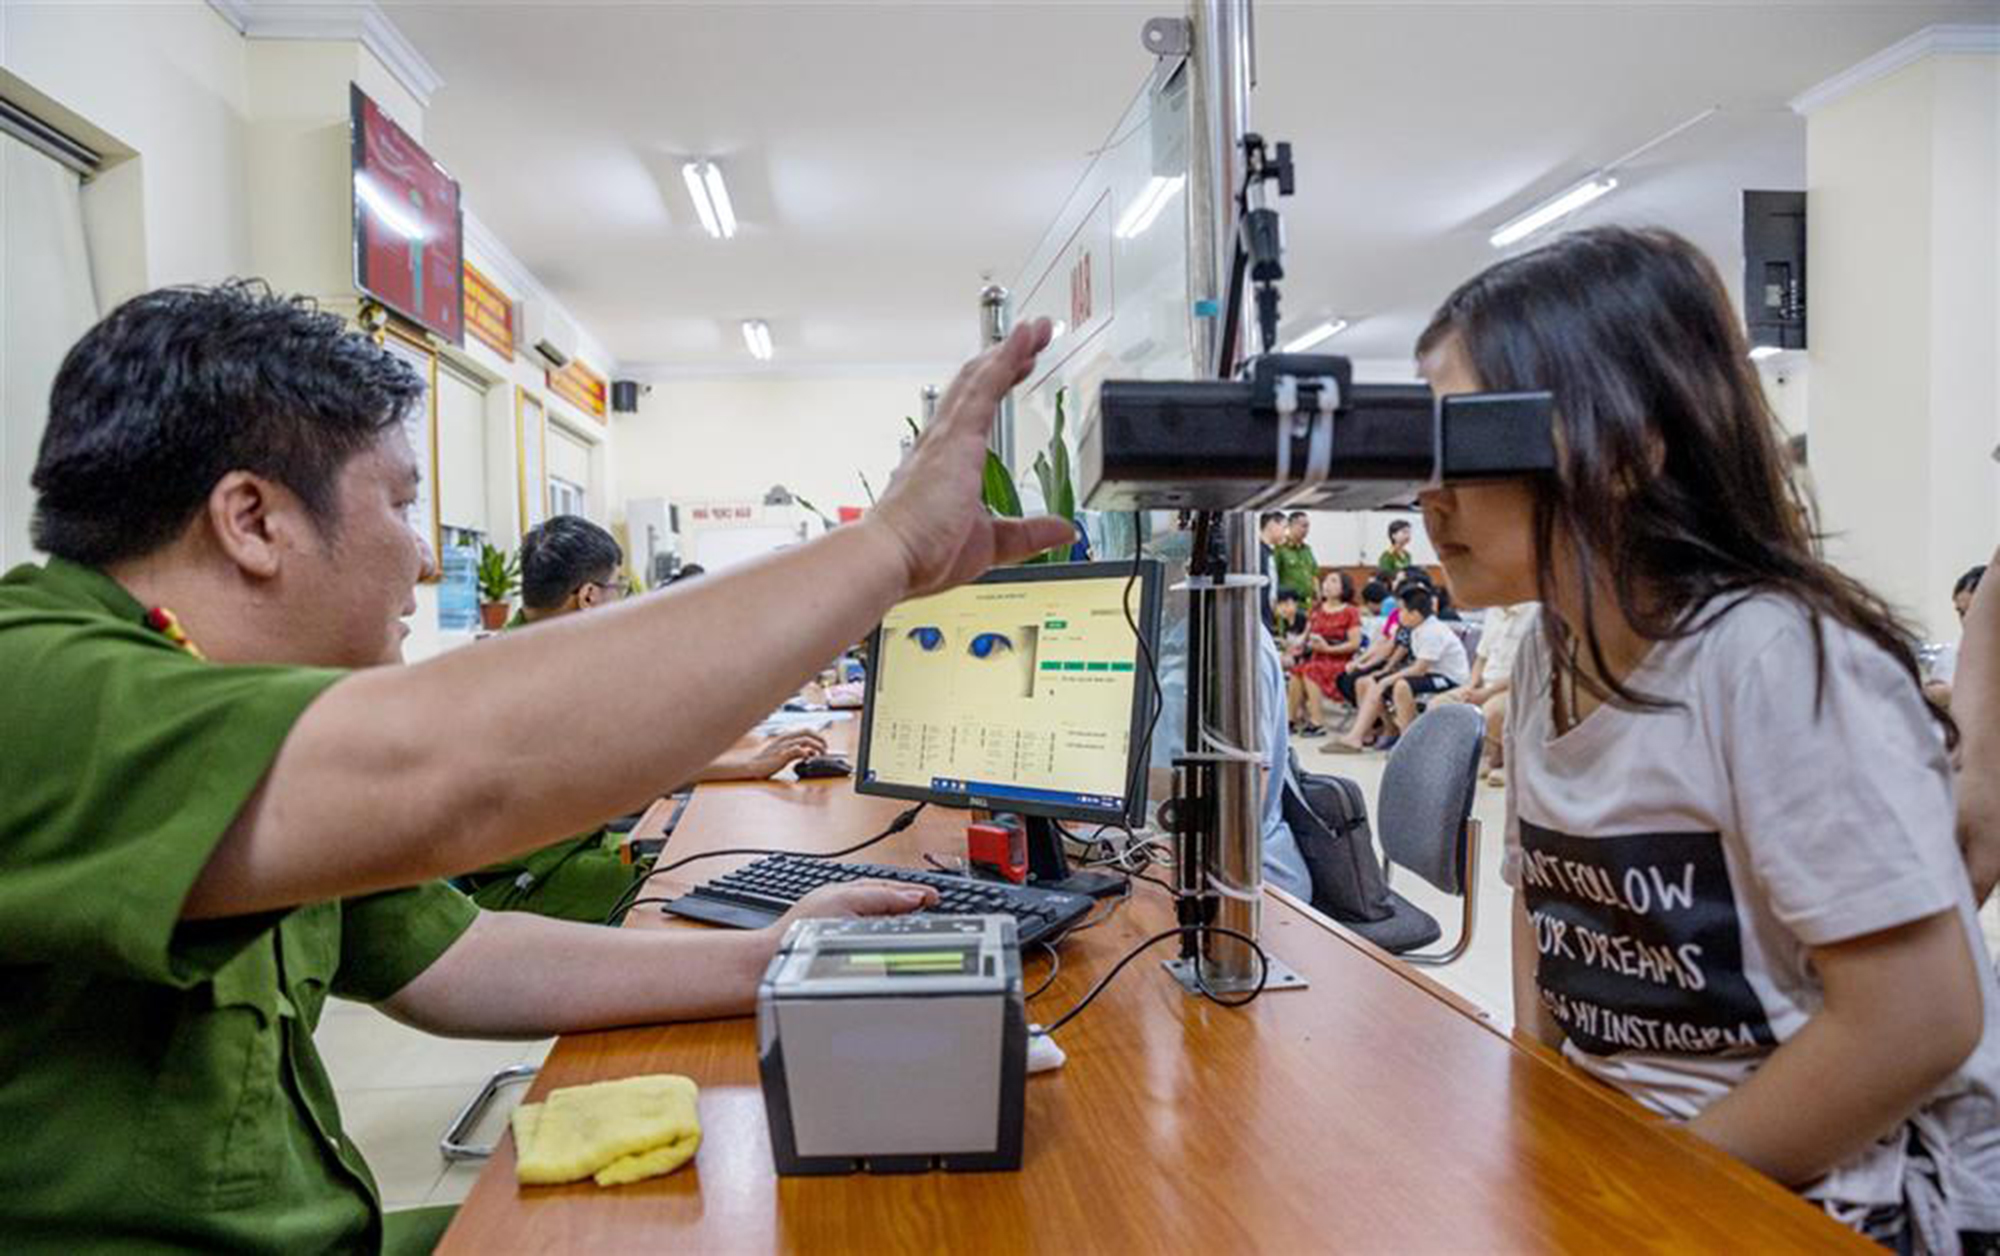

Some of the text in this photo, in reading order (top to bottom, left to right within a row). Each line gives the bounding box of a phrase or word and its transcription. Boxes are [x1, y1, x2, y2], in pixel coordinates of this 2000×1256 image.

[1563, 861, 1695, 914] FOLLOW
[1575, 926, 1706, 991] DREAMS
[1570, 1001, 1598, 1036] MY
